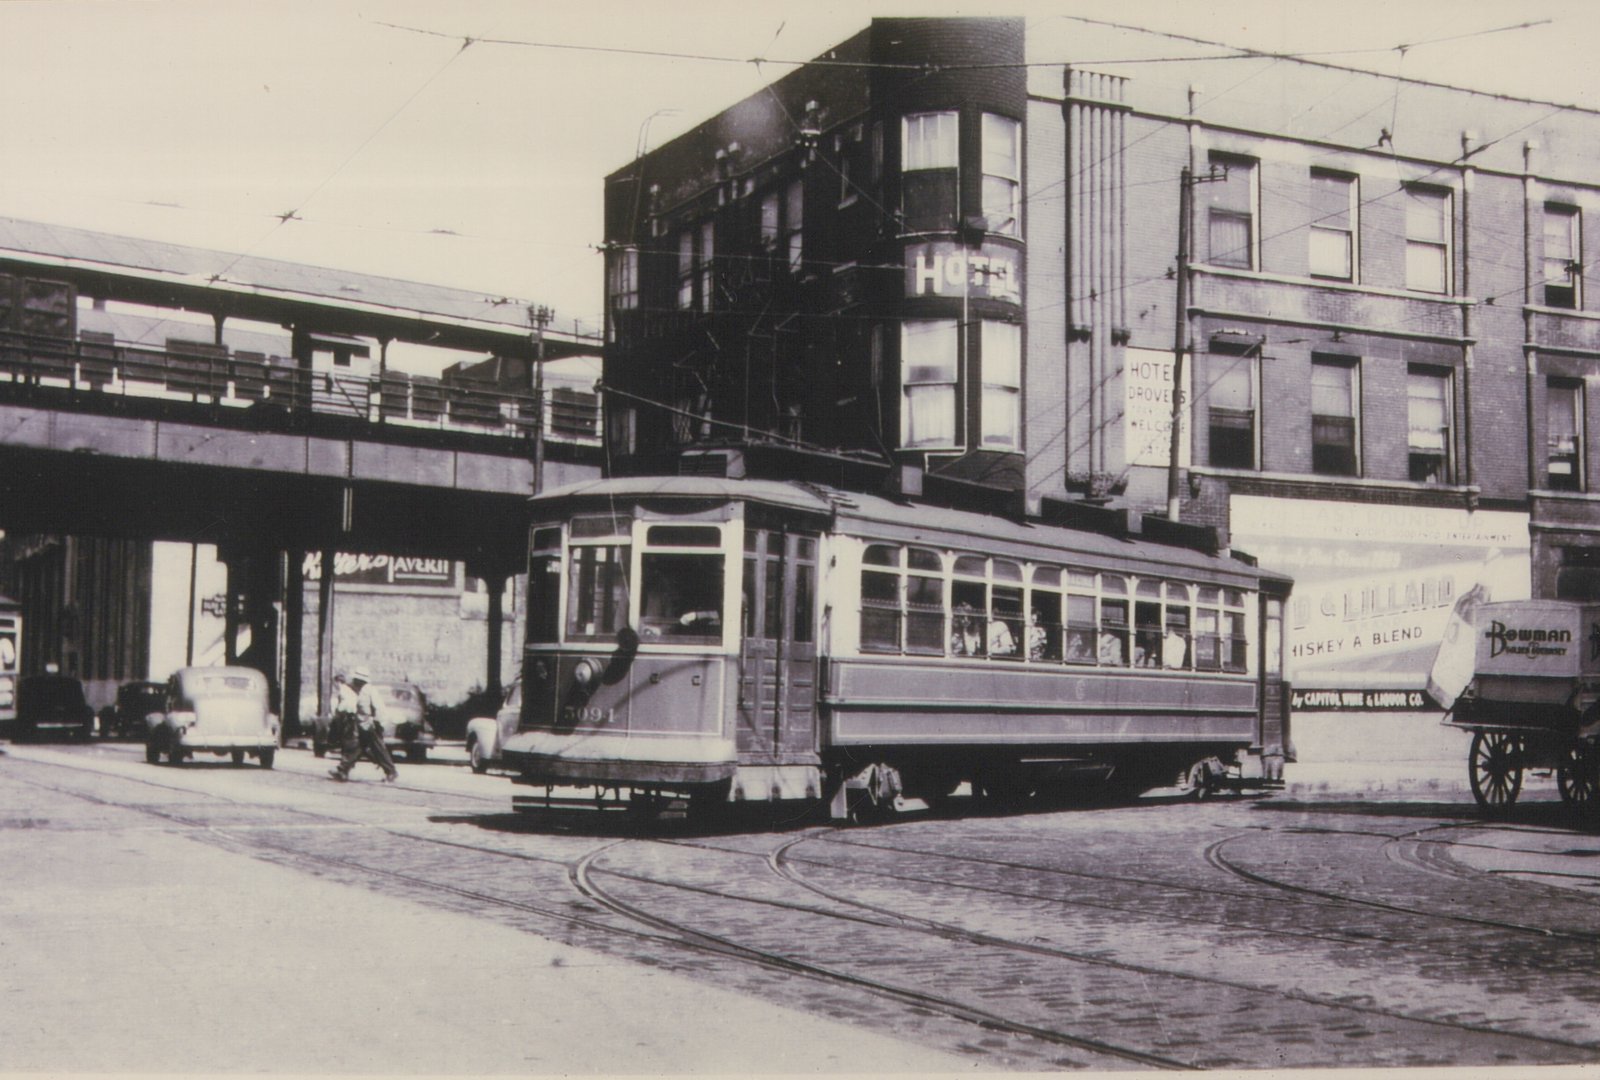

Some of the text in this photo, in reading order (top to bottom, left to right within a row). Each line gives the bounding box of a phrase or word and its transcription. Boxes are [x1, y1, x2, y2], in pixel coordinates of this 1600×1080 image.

[915, 252, 1019, 305] HOTEL
[1130, 361, 1171, 382] HOTE
[1128, 386, 1187, 405] DROVES
[1131, 419, 1186, 434] WELCOE
[1291, 625, 1423, 658] HISKEY A BLEND
[1304, 691, 1342, 706] CAPITOL
[1342, 692, 1364, 707] WINE
[1366, 694, 1374, 707] &
[1374, 692, 1407, 707] LIQUOR
[1409, 692, 1425, 707] CO.
